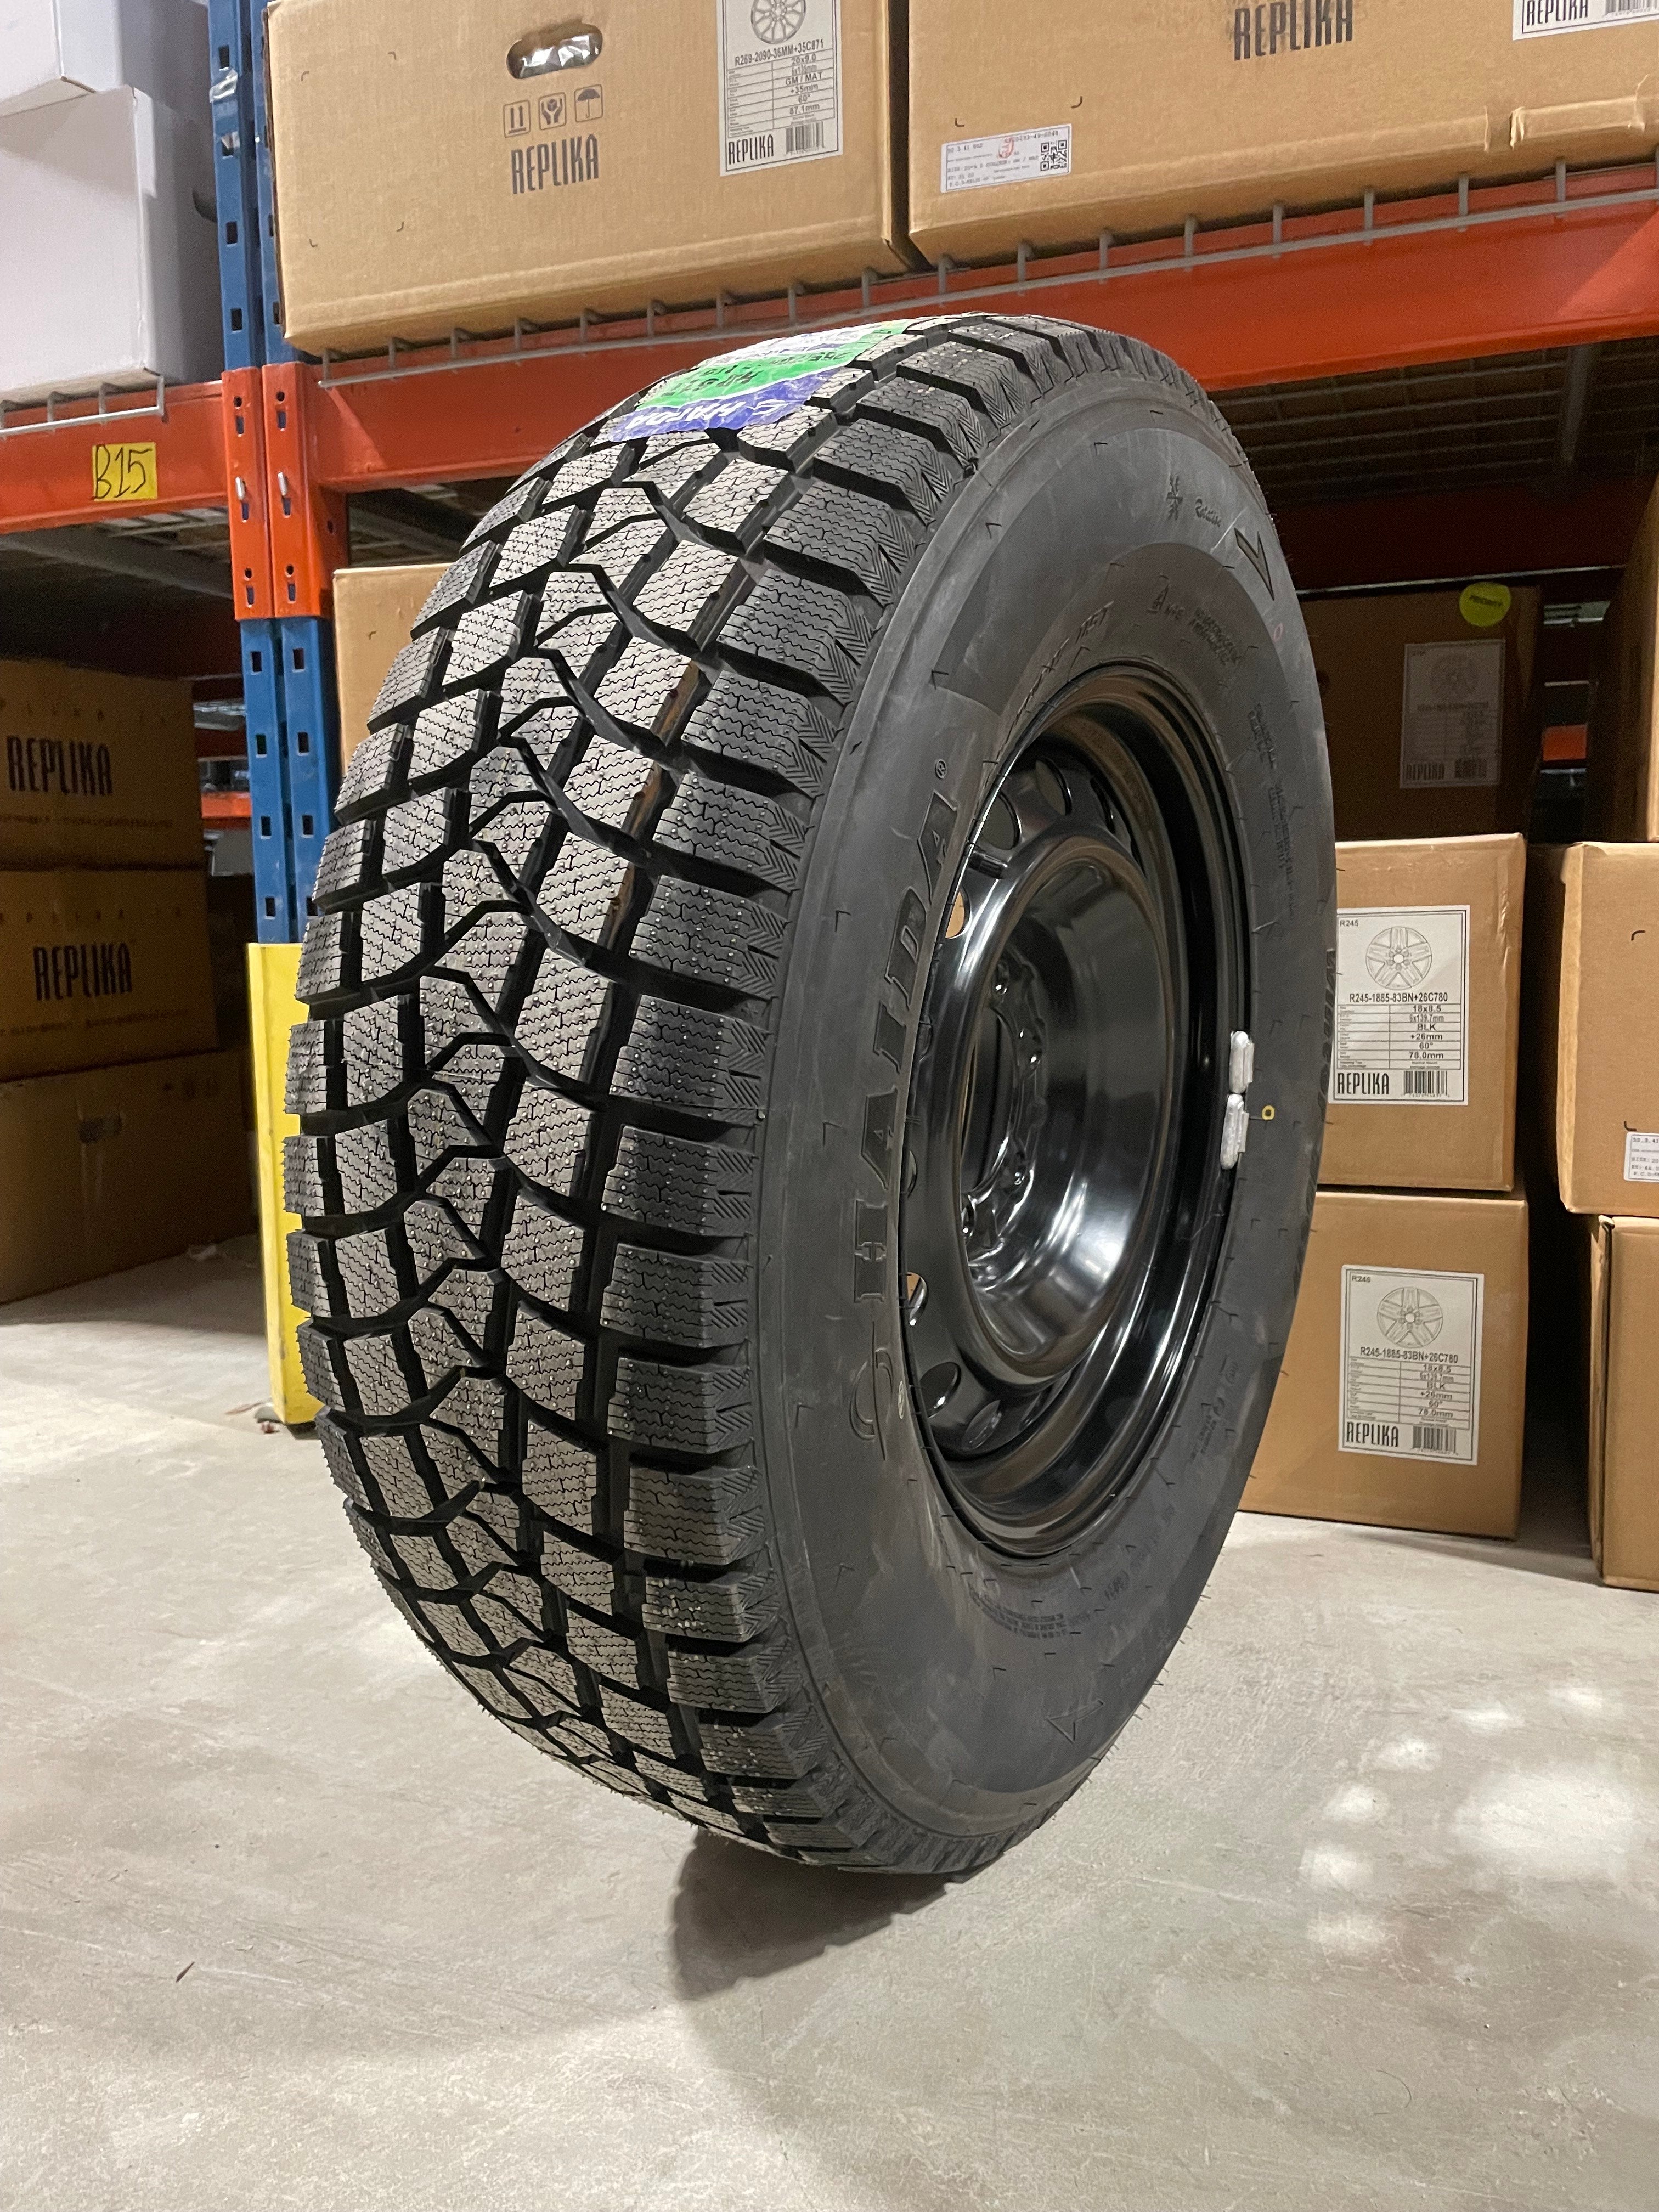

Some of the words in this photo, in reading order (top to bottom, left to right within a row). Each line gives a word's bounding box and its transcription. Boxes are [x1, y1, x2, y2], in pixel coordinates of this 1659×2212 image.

[1526, 0, 1588, 26] REPLIKA
[1234, 0, 1353, 61] REPLIKA
[728, 134, 774, 165] REPLIKA
[511, 133, 599, 194] REPLIKA
[91, 444, 153, 499] B15
[7, 736, 113, 795] REPLIKA
[33, 942, 133, 1001] REPLIKA
[1349, 992, 1448, 1003] R245-1885-83BN+26C780
[1412, 1005, 1442, 1013] 18x8.5
[1417, 1023, 1437, 1031] BLK
[1409, 1051, 1444, 1059] 78.0mm
[1337, 1072, 1390, 1095] REPLIKA
[1346, 1421, 1399, 1448] REPLIKA
